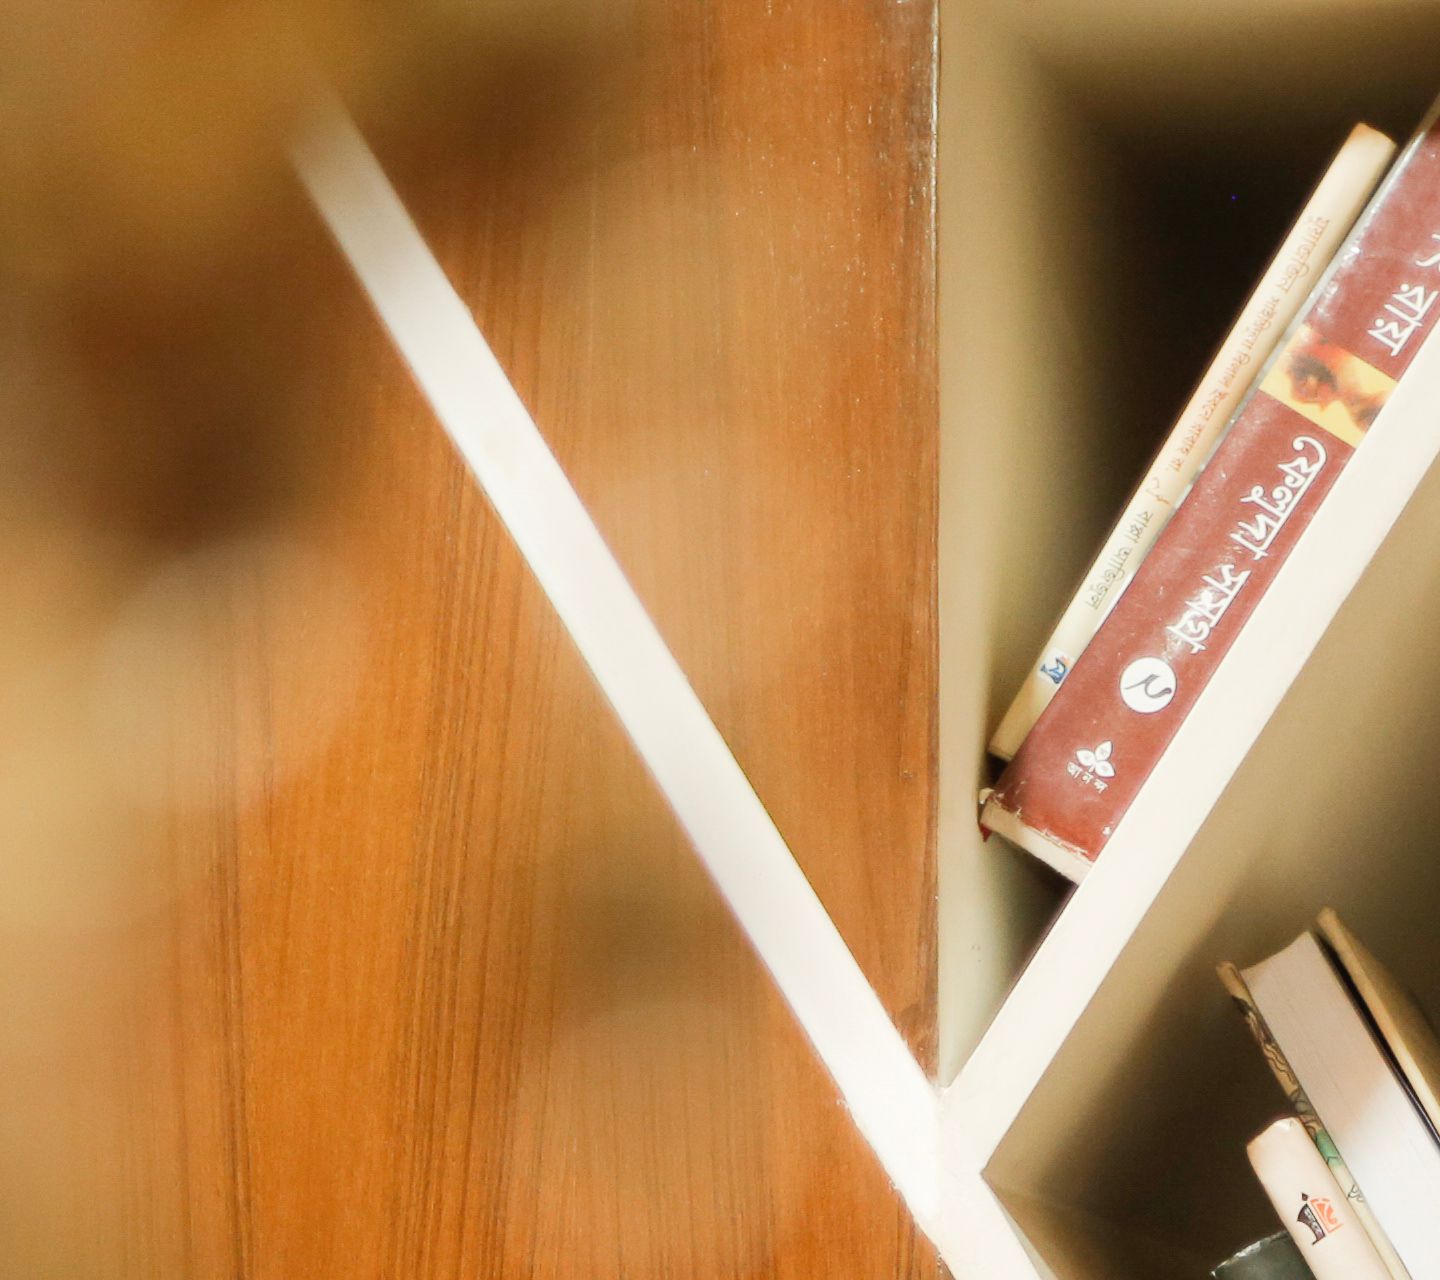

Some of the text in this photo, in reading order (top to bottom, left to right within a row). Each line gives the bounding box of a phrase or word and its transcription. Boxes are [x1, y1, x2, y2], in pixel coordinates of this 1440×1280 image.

[1368, 284, 1438, 356] রায়
[1166, 437, 1326, 653] ফেলুদা সমগ্র
